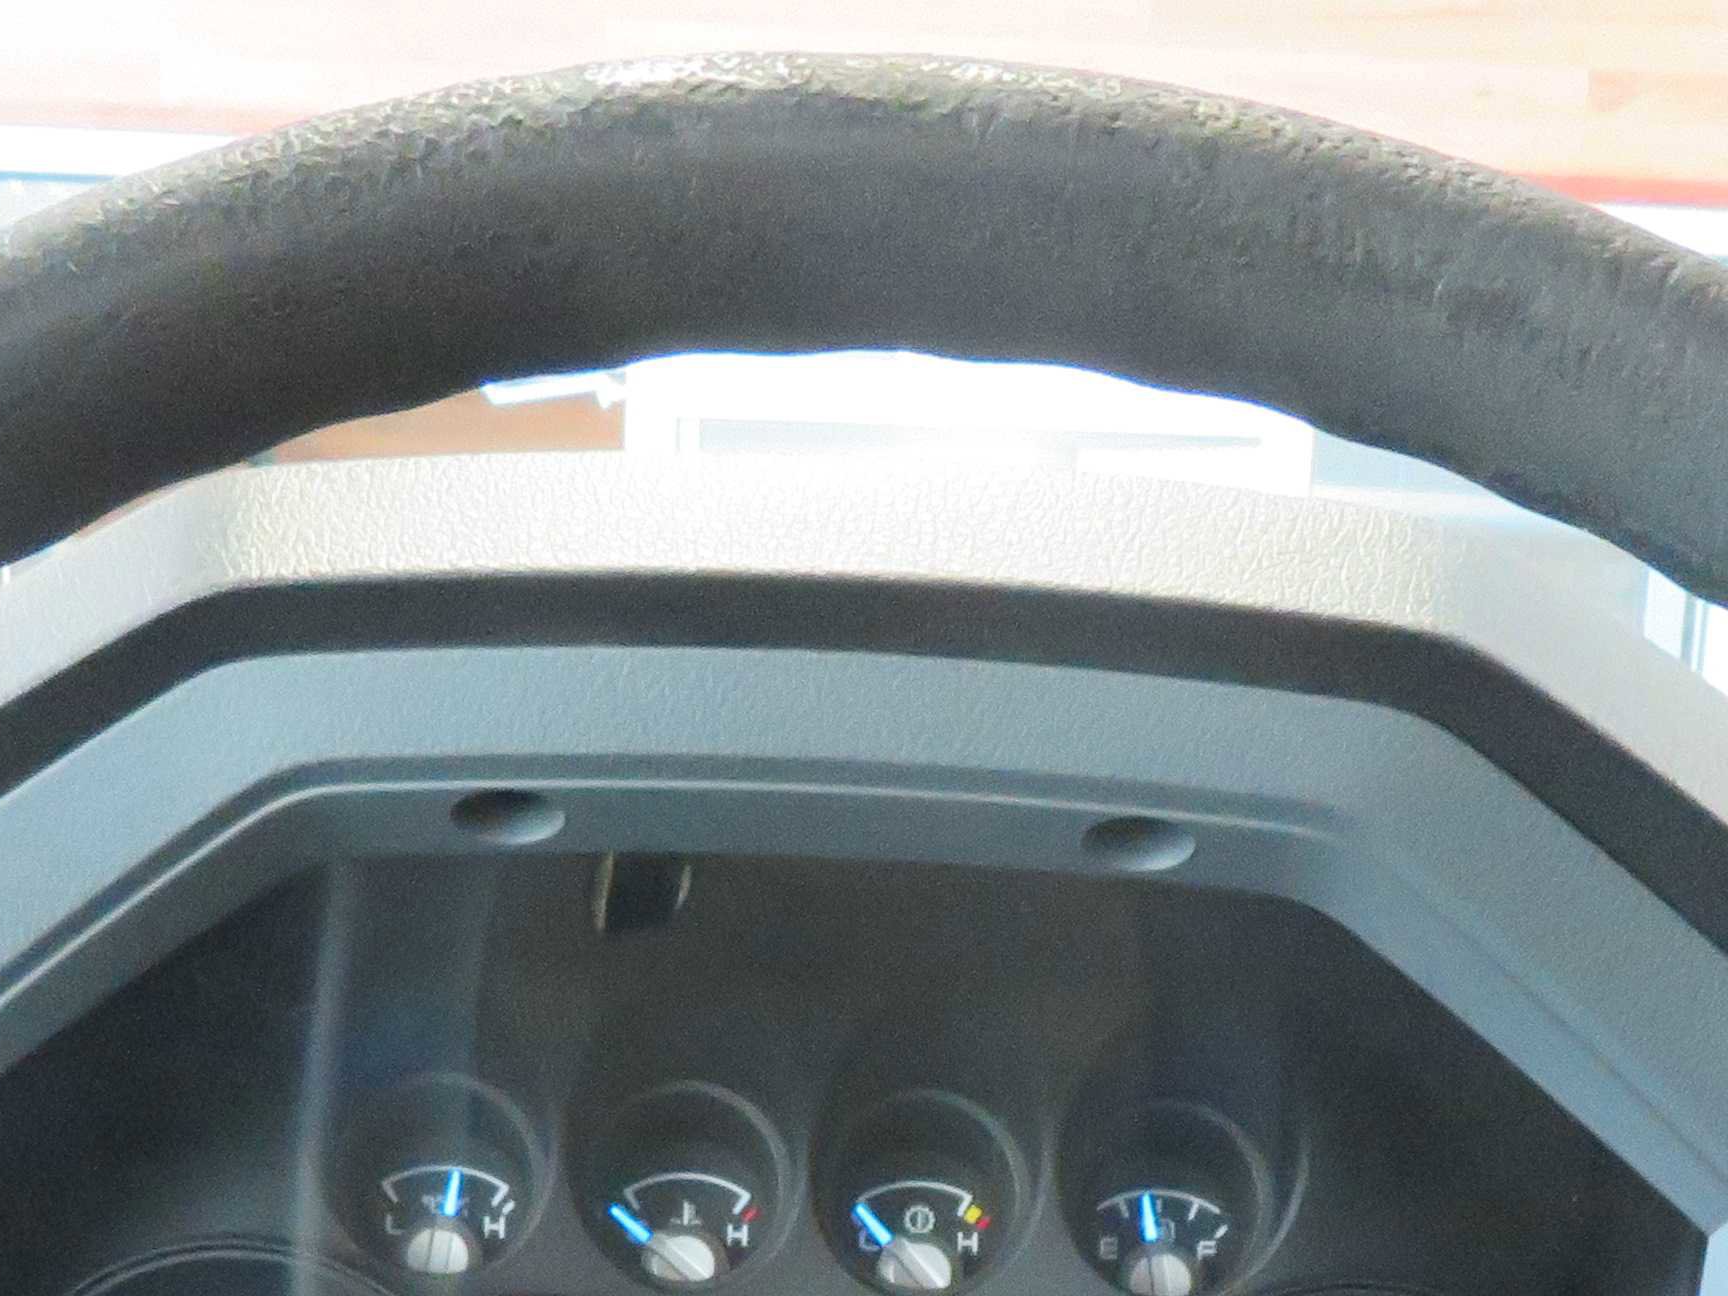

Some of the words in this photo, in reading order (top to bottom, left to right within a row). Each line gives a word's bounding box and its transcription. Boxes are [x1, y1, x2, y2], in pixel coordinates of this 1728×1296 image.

[483, 1215, 506, 1240] H
[726, 1222, 749, 1247] H
[957, 1231, 979, 1256] H
[1197, 1240, 1218, 1261] F
